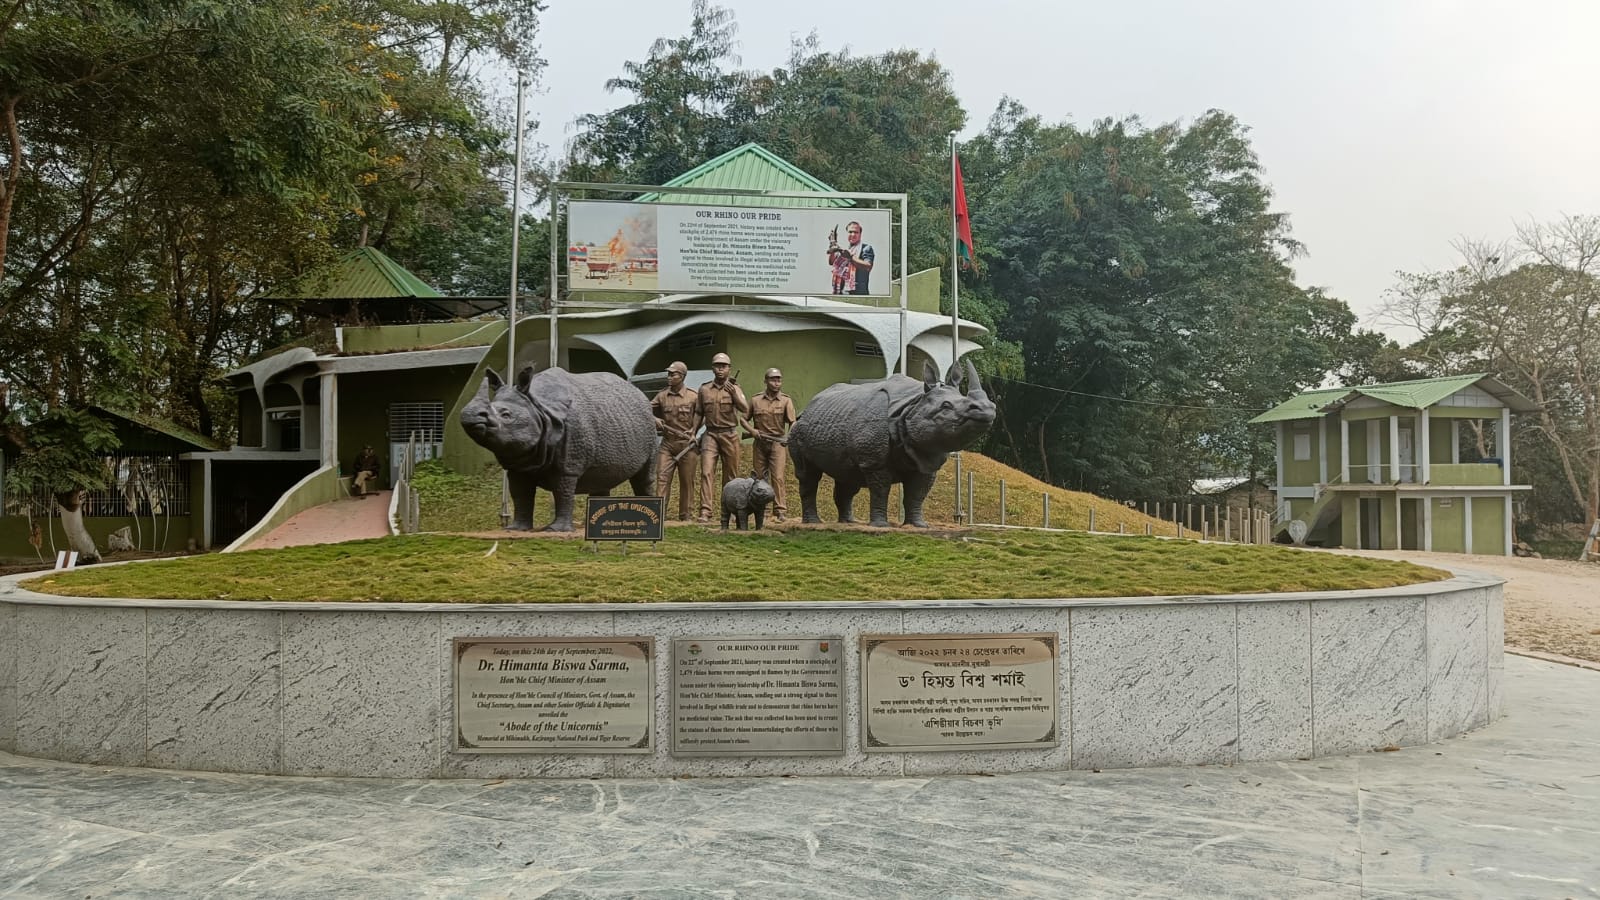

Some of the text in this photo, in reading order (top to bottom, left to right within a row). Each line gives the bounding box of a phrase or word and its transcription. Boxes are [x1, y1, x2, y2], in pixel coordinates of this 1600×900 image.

[714, 211, 739, 219] RHINO
[740, 212, 757, 220] OUR
[478, 658, 629, 672] Dr. Himanta Biswa Sarma,
[528, 675, 548, 685] Chief
[547, 676, 576, 684] Minister
[576, 675, 586, 685] of
[584, 676, 607, 684] Assam
[897, 670, 1026, 689] ড° হিমন্ত বিশ্ব শৰ্মাই
[499, 721, 609, 733] “Abode of the Unicornis”
